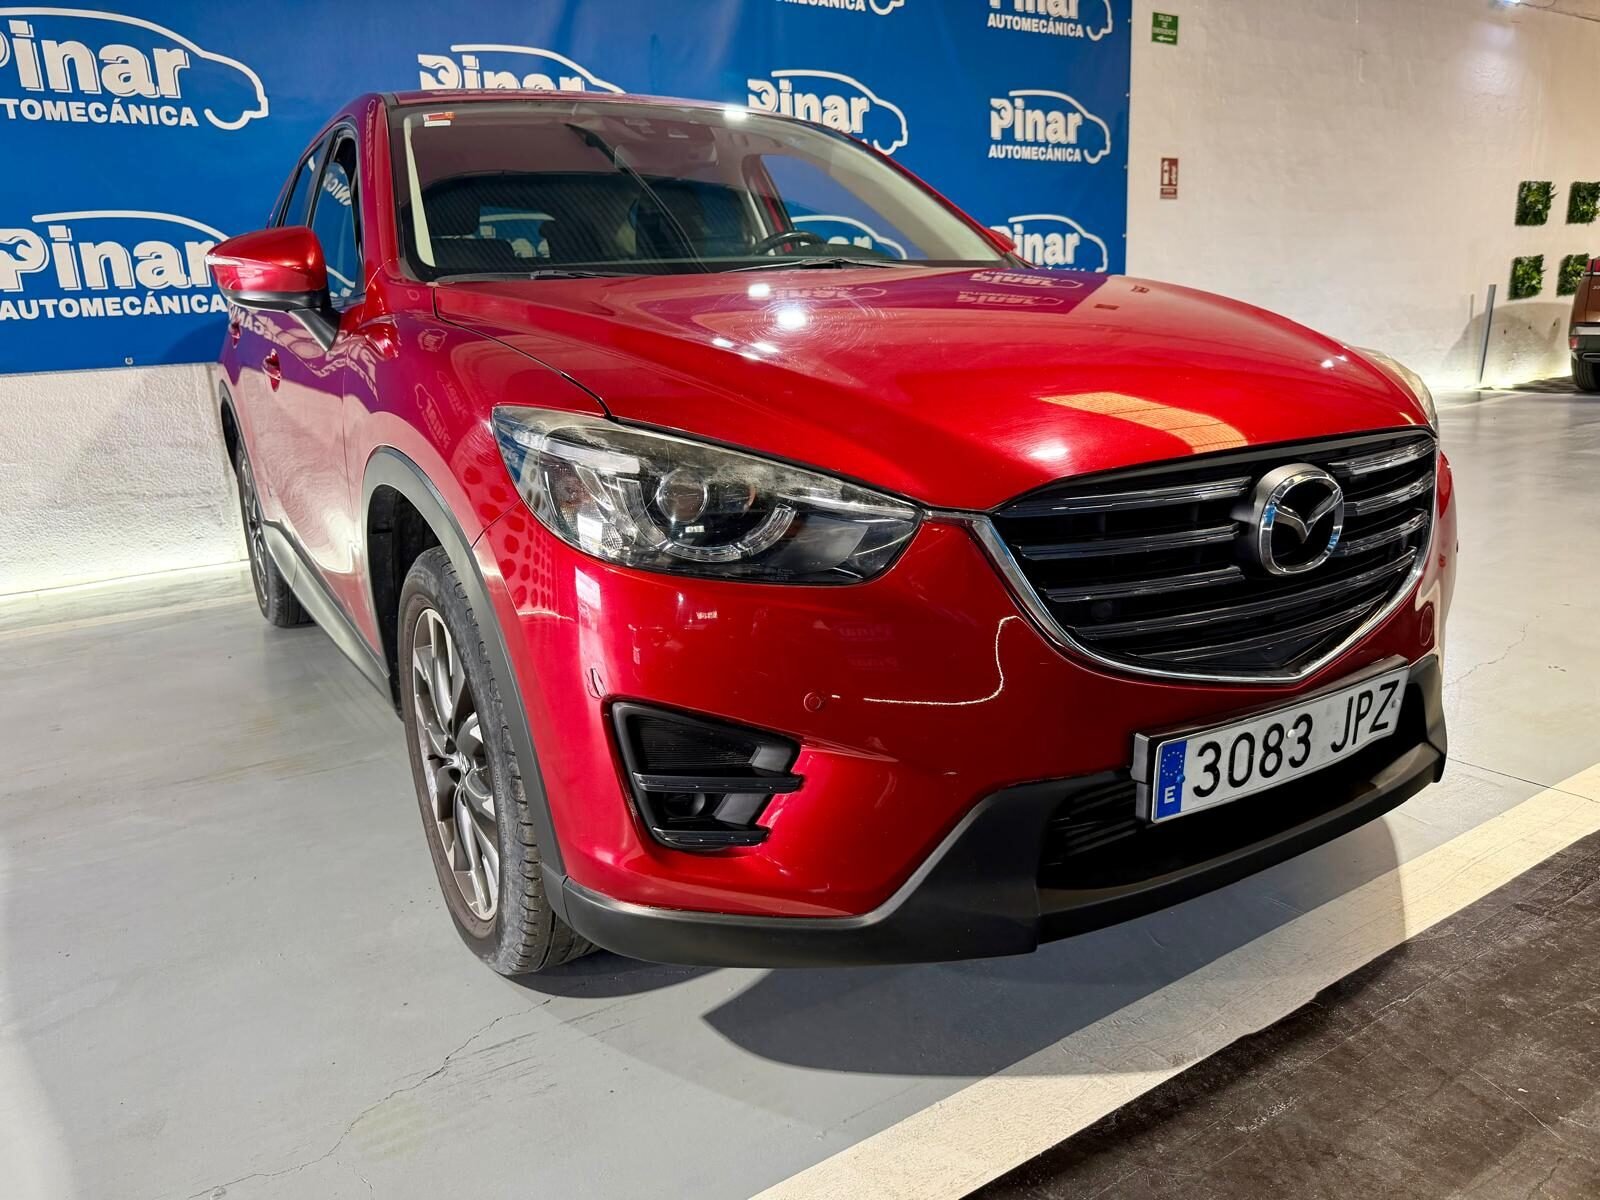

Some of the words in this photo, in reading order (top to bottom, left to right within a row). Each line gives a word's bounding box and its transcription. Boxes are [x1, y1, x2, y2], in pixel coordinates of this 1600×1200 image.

[987, 13, 1084, 38] AUTOMECÁNICA
[0, 19, 190, 99] inar
[990, 98, 1082, 144] Pinar
[988, 144, 1081, 162] AUTOMECÁNICA
[0, 290, 228, 321] AUTOMECÁNICA
[1164, 785, 1176, 804] E
[1193, 713, 1313, 798] 3083
[1330, 680, 1400, 753] JPZ
